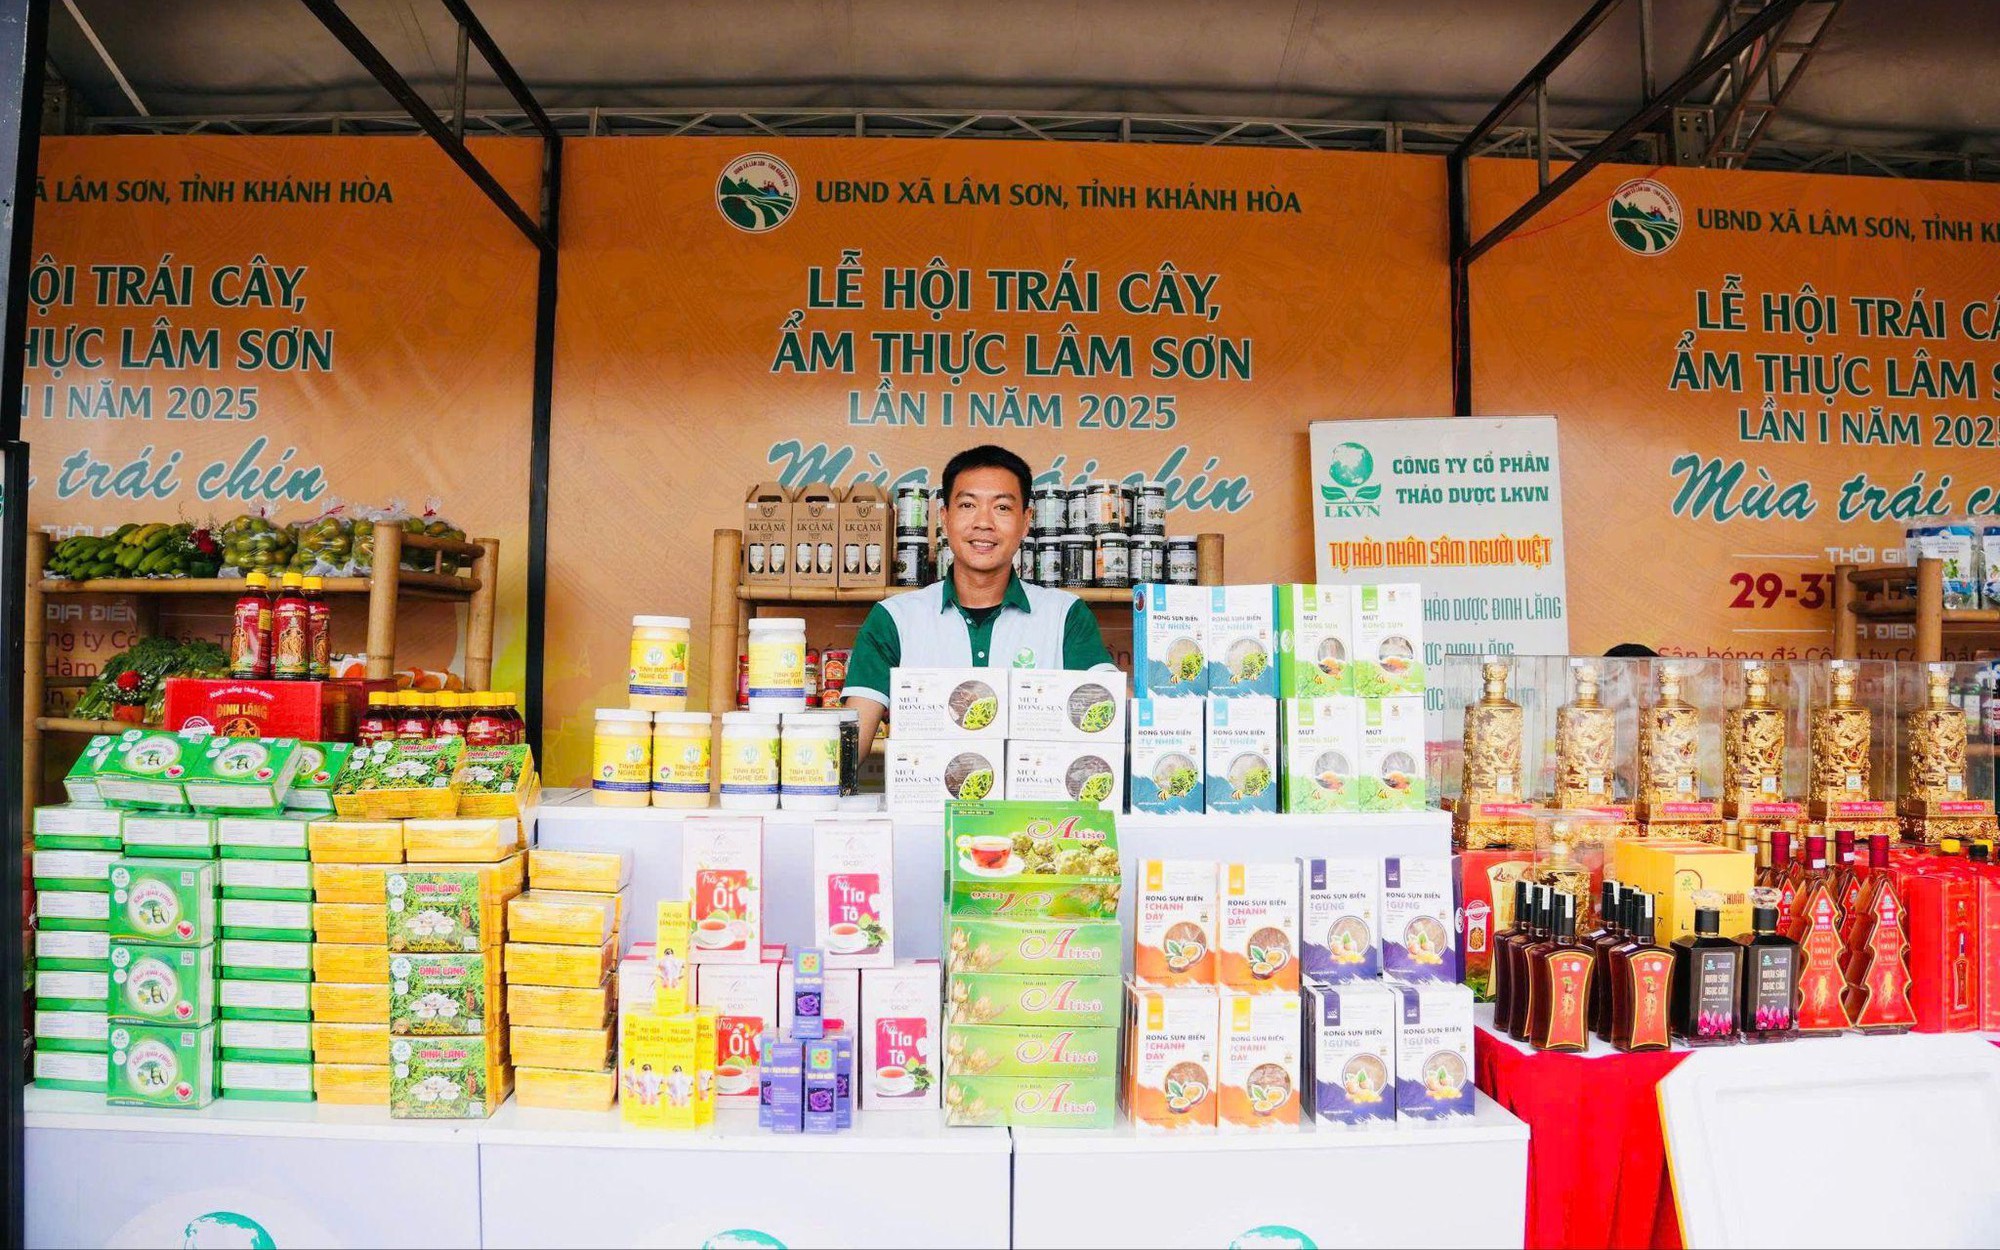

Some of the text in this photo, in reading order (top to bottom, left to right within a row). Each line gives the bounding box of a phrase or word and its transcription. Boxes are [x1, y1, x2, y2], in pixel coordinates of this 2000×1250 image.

[34, 173, 394, 206] Ã LÂM SƠN, TỈNH KHÁNH HÒA
[815, 177, 1302, 214] UBND XÃ LÂM SƠN, TỈNH KHÁNH HÒA
[1697, 208, 1762, 232] UBND
[1769, 208, 1802, 234] XÃ
[1809, 209, 1858, 237] LÂM
[1866, 216, 1916, 242] SƠN,
[1922, 212, 1973, 242] TỈNH
[28, 253, 307, 317] ỘI TRÁI CÂY,
[807, 249, 1221, 322] LỄ HỘI TRÁI CÂY,
[1696, 273, 1747, 331] LỄ
[1761, 283, 1838, 345] HỘI
[1849, 287, 1947, 341] TRÁI
[24, 315, 335, 379] HỰC LÂM SƠN
[771, 310, 1252, 386] ẨM THỰC LÂM SƠN
[1668, 331, 1743, 392] ẨM
[1755, 352, 1873, 406] THỰC
[1885, 348, 1978, 401] LÂM
[42, 385, 54, 418] I
[66, 377, 153, 420] NĂM
[165, 386, 260, 422] 2025
[848, 374, 1177, 431] LẦN I NĂM 2025
[1739, 396, 2000, 448] LẦN I NĂM 202
[56, 435, 329, 502] trái chín
[1393, 450, 1550, 475] CÔNG TY CỔ PHẦN
[1396, 484, 1549, 506] THẢO DƯỢC LKVN
[1671, 453, 1818, 523] Mùa
[1837, 471, 1952, 522] trái
[1325, 505, 1381, 518] LKVN
[1329, 534, 1552, 574] TỰ HÀO NHÂN SÂM NGƯỜI VIỆT
[1824, 544, 1876, 564] THỜI
[46, 604, 82, 623] ĐỊA
[1424, 592, 1561, 626] HẢO DƯỢC ĐINH LĂNG
[46, 630, 105, 652] ng ty
[713, 875, 734, 909] Ổi
[841, 888, 865, 903] Tía
[841, 905, 859, 921] Tô
[729, 1022, 749, 1055] Ổi
[889, 1031, 912, 1047] Tía
[888, 1049, 906, 1065] Tô
